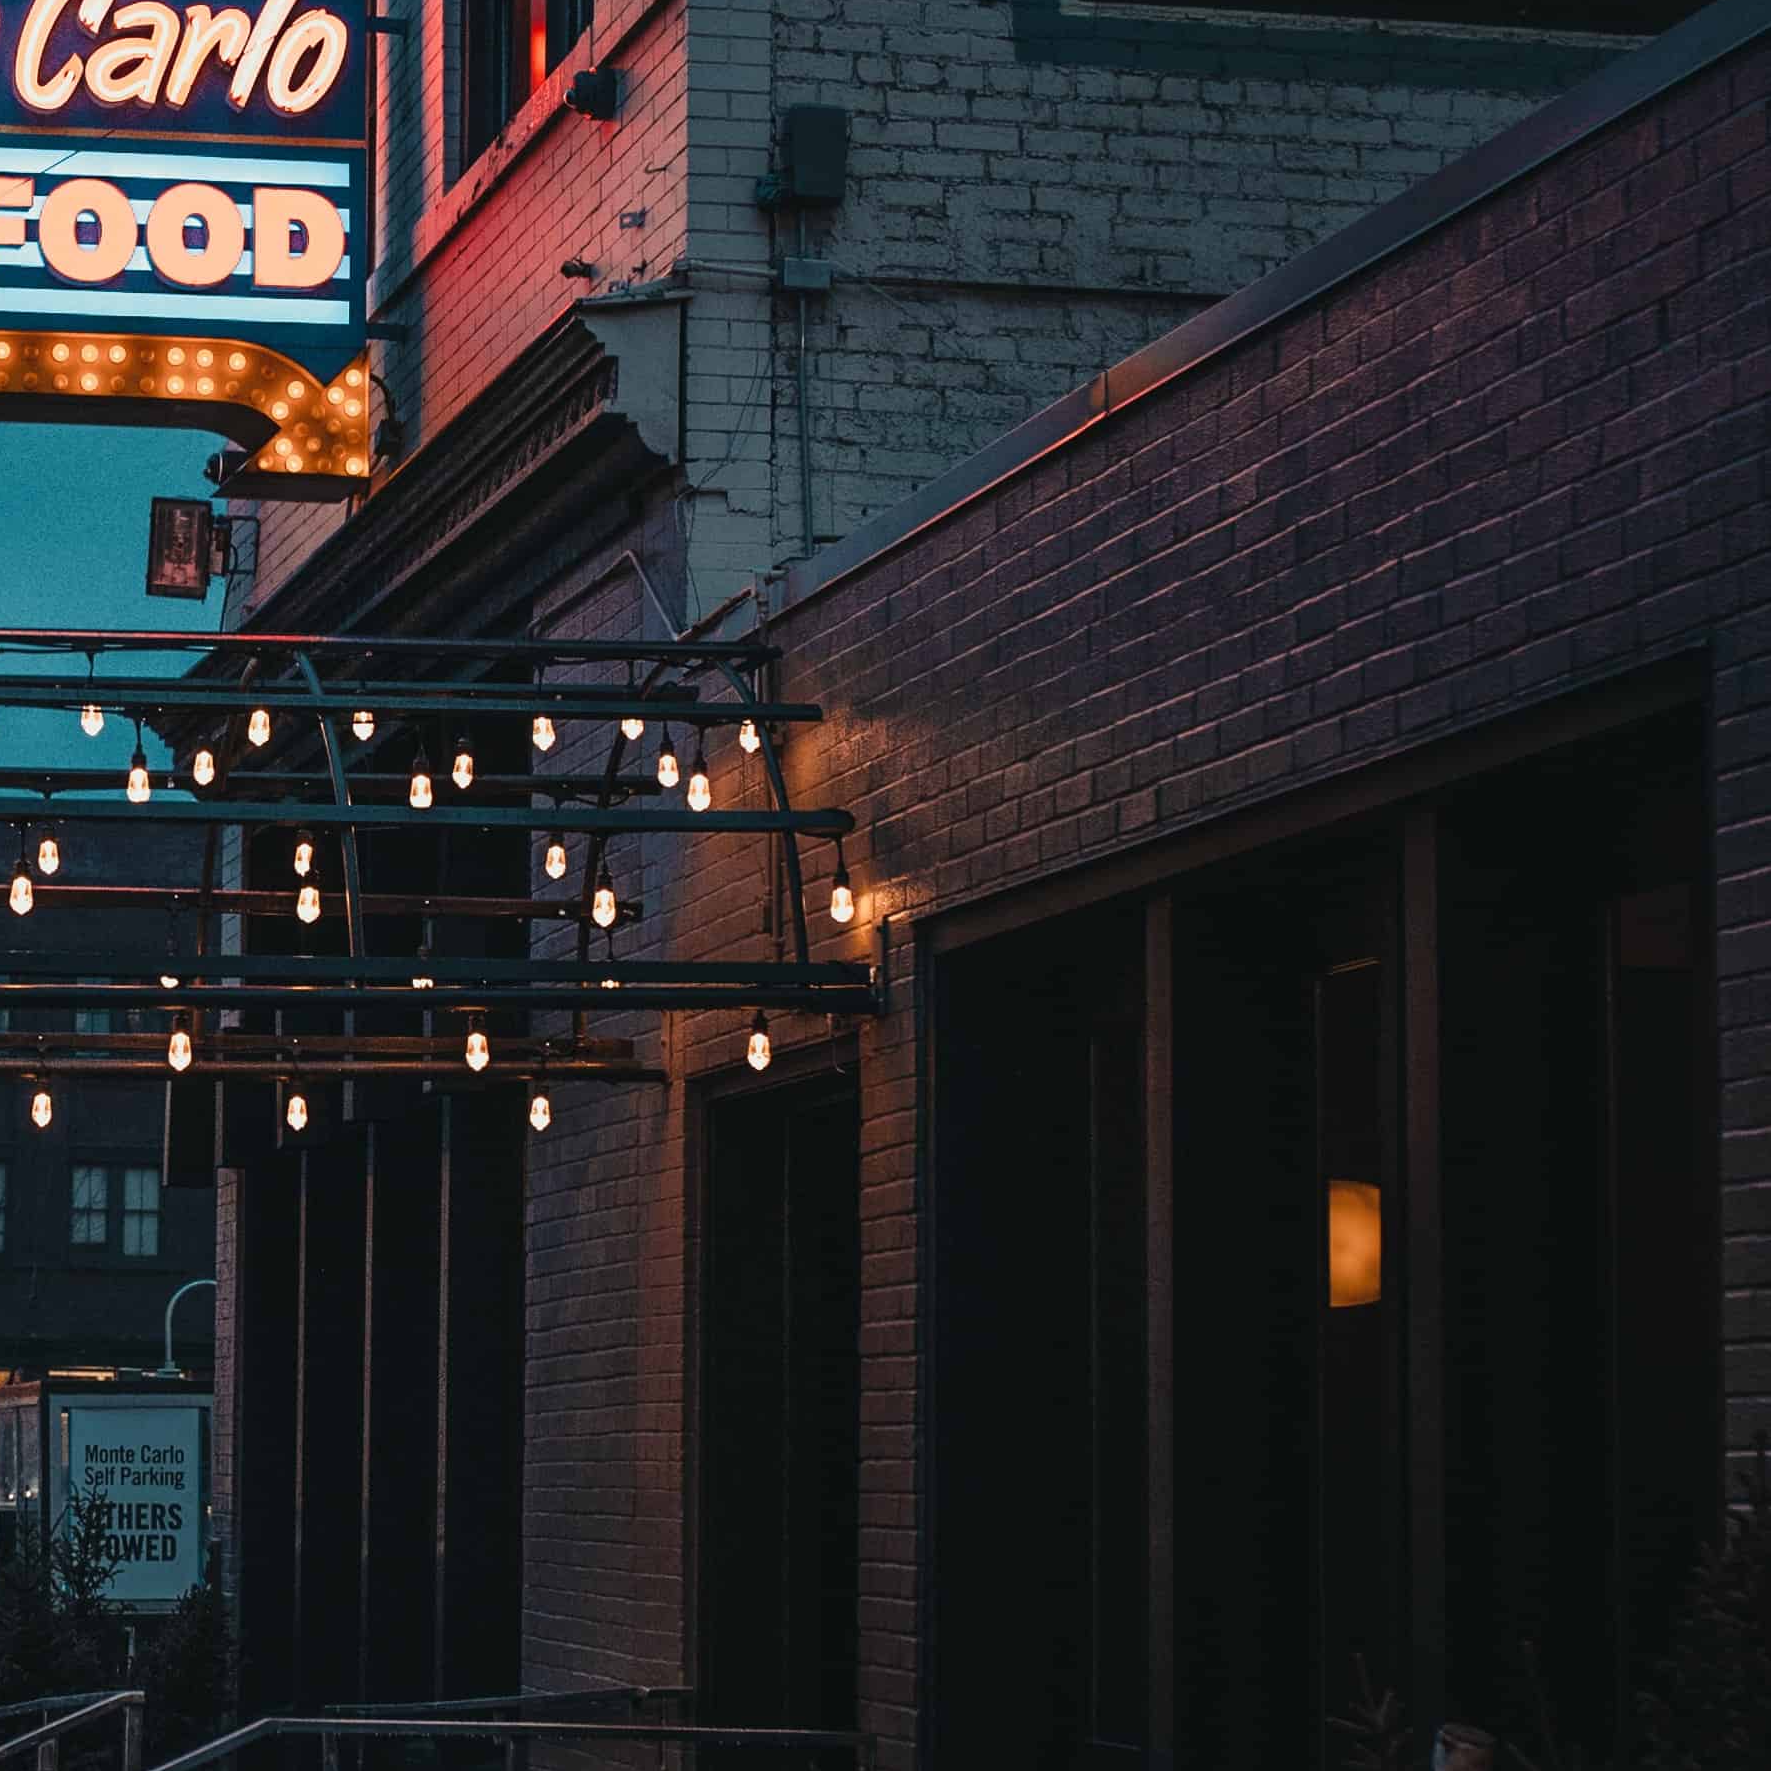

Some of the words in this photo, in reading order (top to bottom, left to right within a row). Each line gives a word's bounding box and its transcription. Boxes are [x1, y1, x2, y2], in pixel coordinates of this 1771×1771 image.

[84, 1444, 135, 1464] Monte
[140, 1444, 185, 1464] Carlo
[84, 1466, 115, 1486] Self
[120, 1467, 185, 1490] Parking
[89, 1502, 182, 1530] THERS
[91, 1533, 177, 1562] OWED
